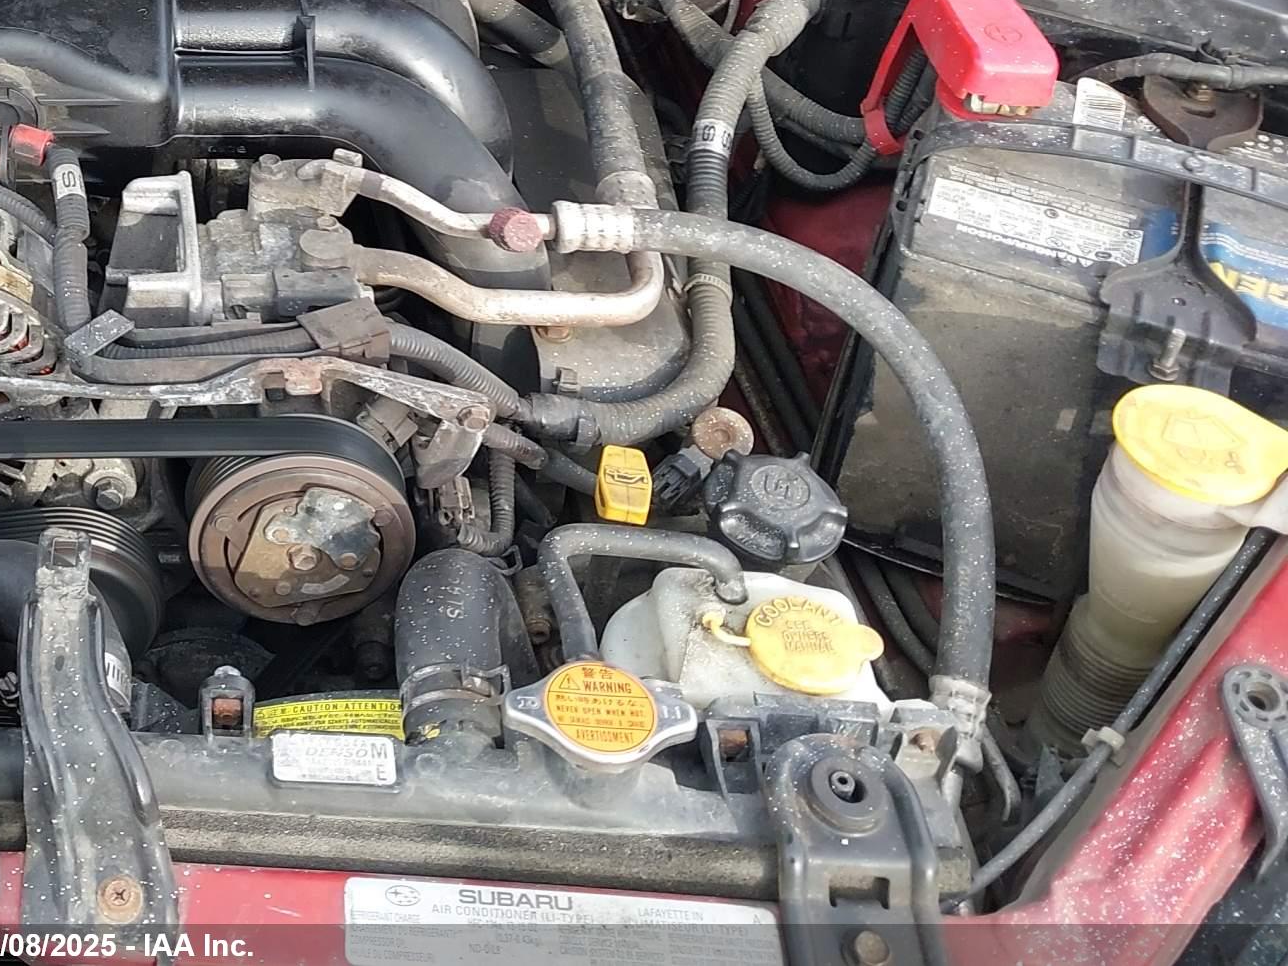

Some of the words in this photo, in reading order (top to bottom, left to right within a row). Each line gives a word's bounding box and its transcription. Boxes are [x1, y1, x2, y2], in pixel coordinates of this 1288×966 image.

[754, 597, 844, 628] COOLANT
[583, 680, 632, 694] WARNING
[293, 703, 339, 713] CAUTION
[582, 707, 601, 715] OPEN
[305, 746, 368, 759] DENSO
[371, 742, 388, 760] M
[376, 763, 388, 782] E
[458, 889, 573, 911] SUBARU
[431, 904, 452, 915] AIR
[456, 905, 537, 921] CONDITIONER
[638, 907, 691, 920] LAFAYETTE
[694, 911, 703, 921] IN
